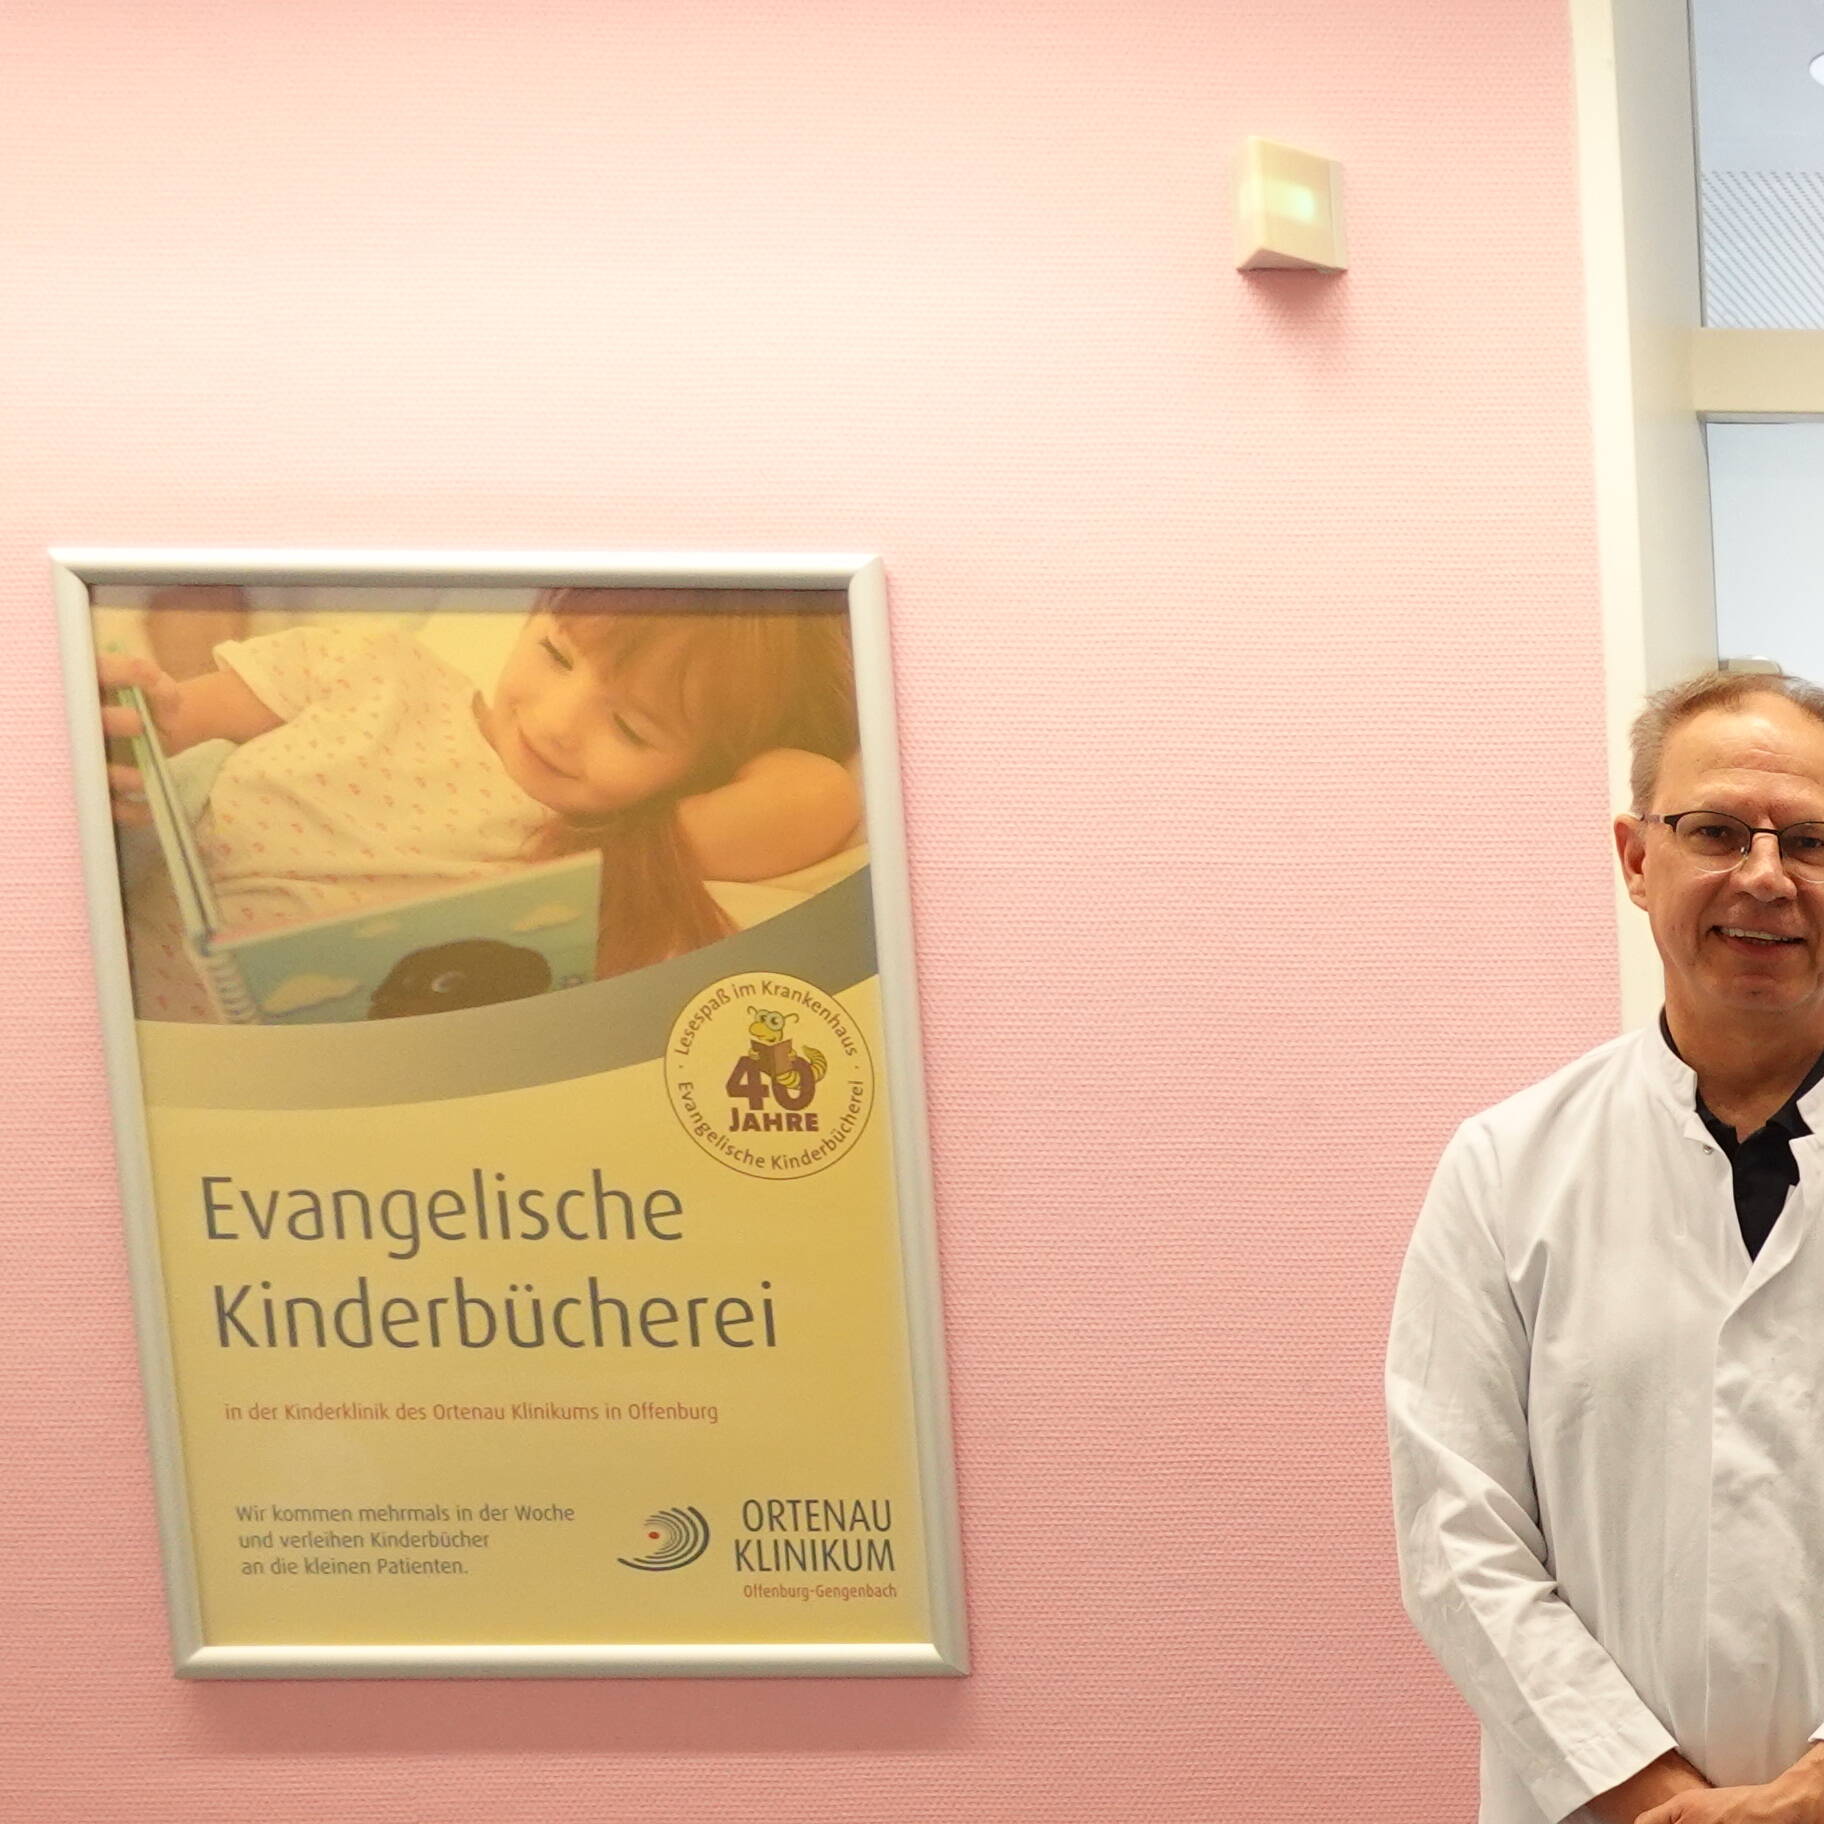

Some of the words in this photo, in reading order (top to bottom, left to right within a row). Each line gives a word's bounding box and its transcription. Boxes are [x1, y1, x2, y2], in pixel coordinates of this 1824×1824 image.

[674, 988, 731, 1056] Lesespaß
[732, 983, 757, 1000] im
[761, 980, 858, 1056] Krankenhaus
[725, 1055, 816, 1111] 40
[678, 1081, 766, 1169] Evangelische
[771, 1080, 864, 1170] Kinderbücherei
[729, 1107, 820, 1132] JAHRE
[200, 1168, 684, 1259] Evangelische
[213, 1276, 777, 1349] Kinderbücherei
[225, 1403, 242, 1420] in
[248, 1403, 278, 1420] der
[285, 1403, 389, 1420] Kinderklinik
[396, 1403, 426, 1420] des
[433, 1403, 505, 1420] Ortenau
[512, 1403, 598, 1420] Klinikums
[605, 1403, 622, 1420] in
[628, 1403, 718, 1424] Offenburg
[236, 1504, 266, 1523] Wir
[272, 1504, 353, 1523] kommen
[358, 1504, 450, 1523] mehrmals
[456, 1504, 473, 1523] in
[479, 1504, 509, 1523] der
[514, 1504, 575, 1523] Woche
[741, 1499, 892, 1532] ORTENAU
[239, 1531, 273, 1550] und
[280, 1531, 365, 1550] verleihen
[371, 1531, 489, 1550] Kinderbücher
[734, 1538, 897, 1573] KLINIKUM
[241, 1557, 265, 1576] an
[269, 1556, 298, 1576] die
[304, 1556, 371, 1576] kleinen
[377, 1557, 468, 1576] Patienten.
[743, 1584, 898, 1600] Offenburg-Gengenbach
